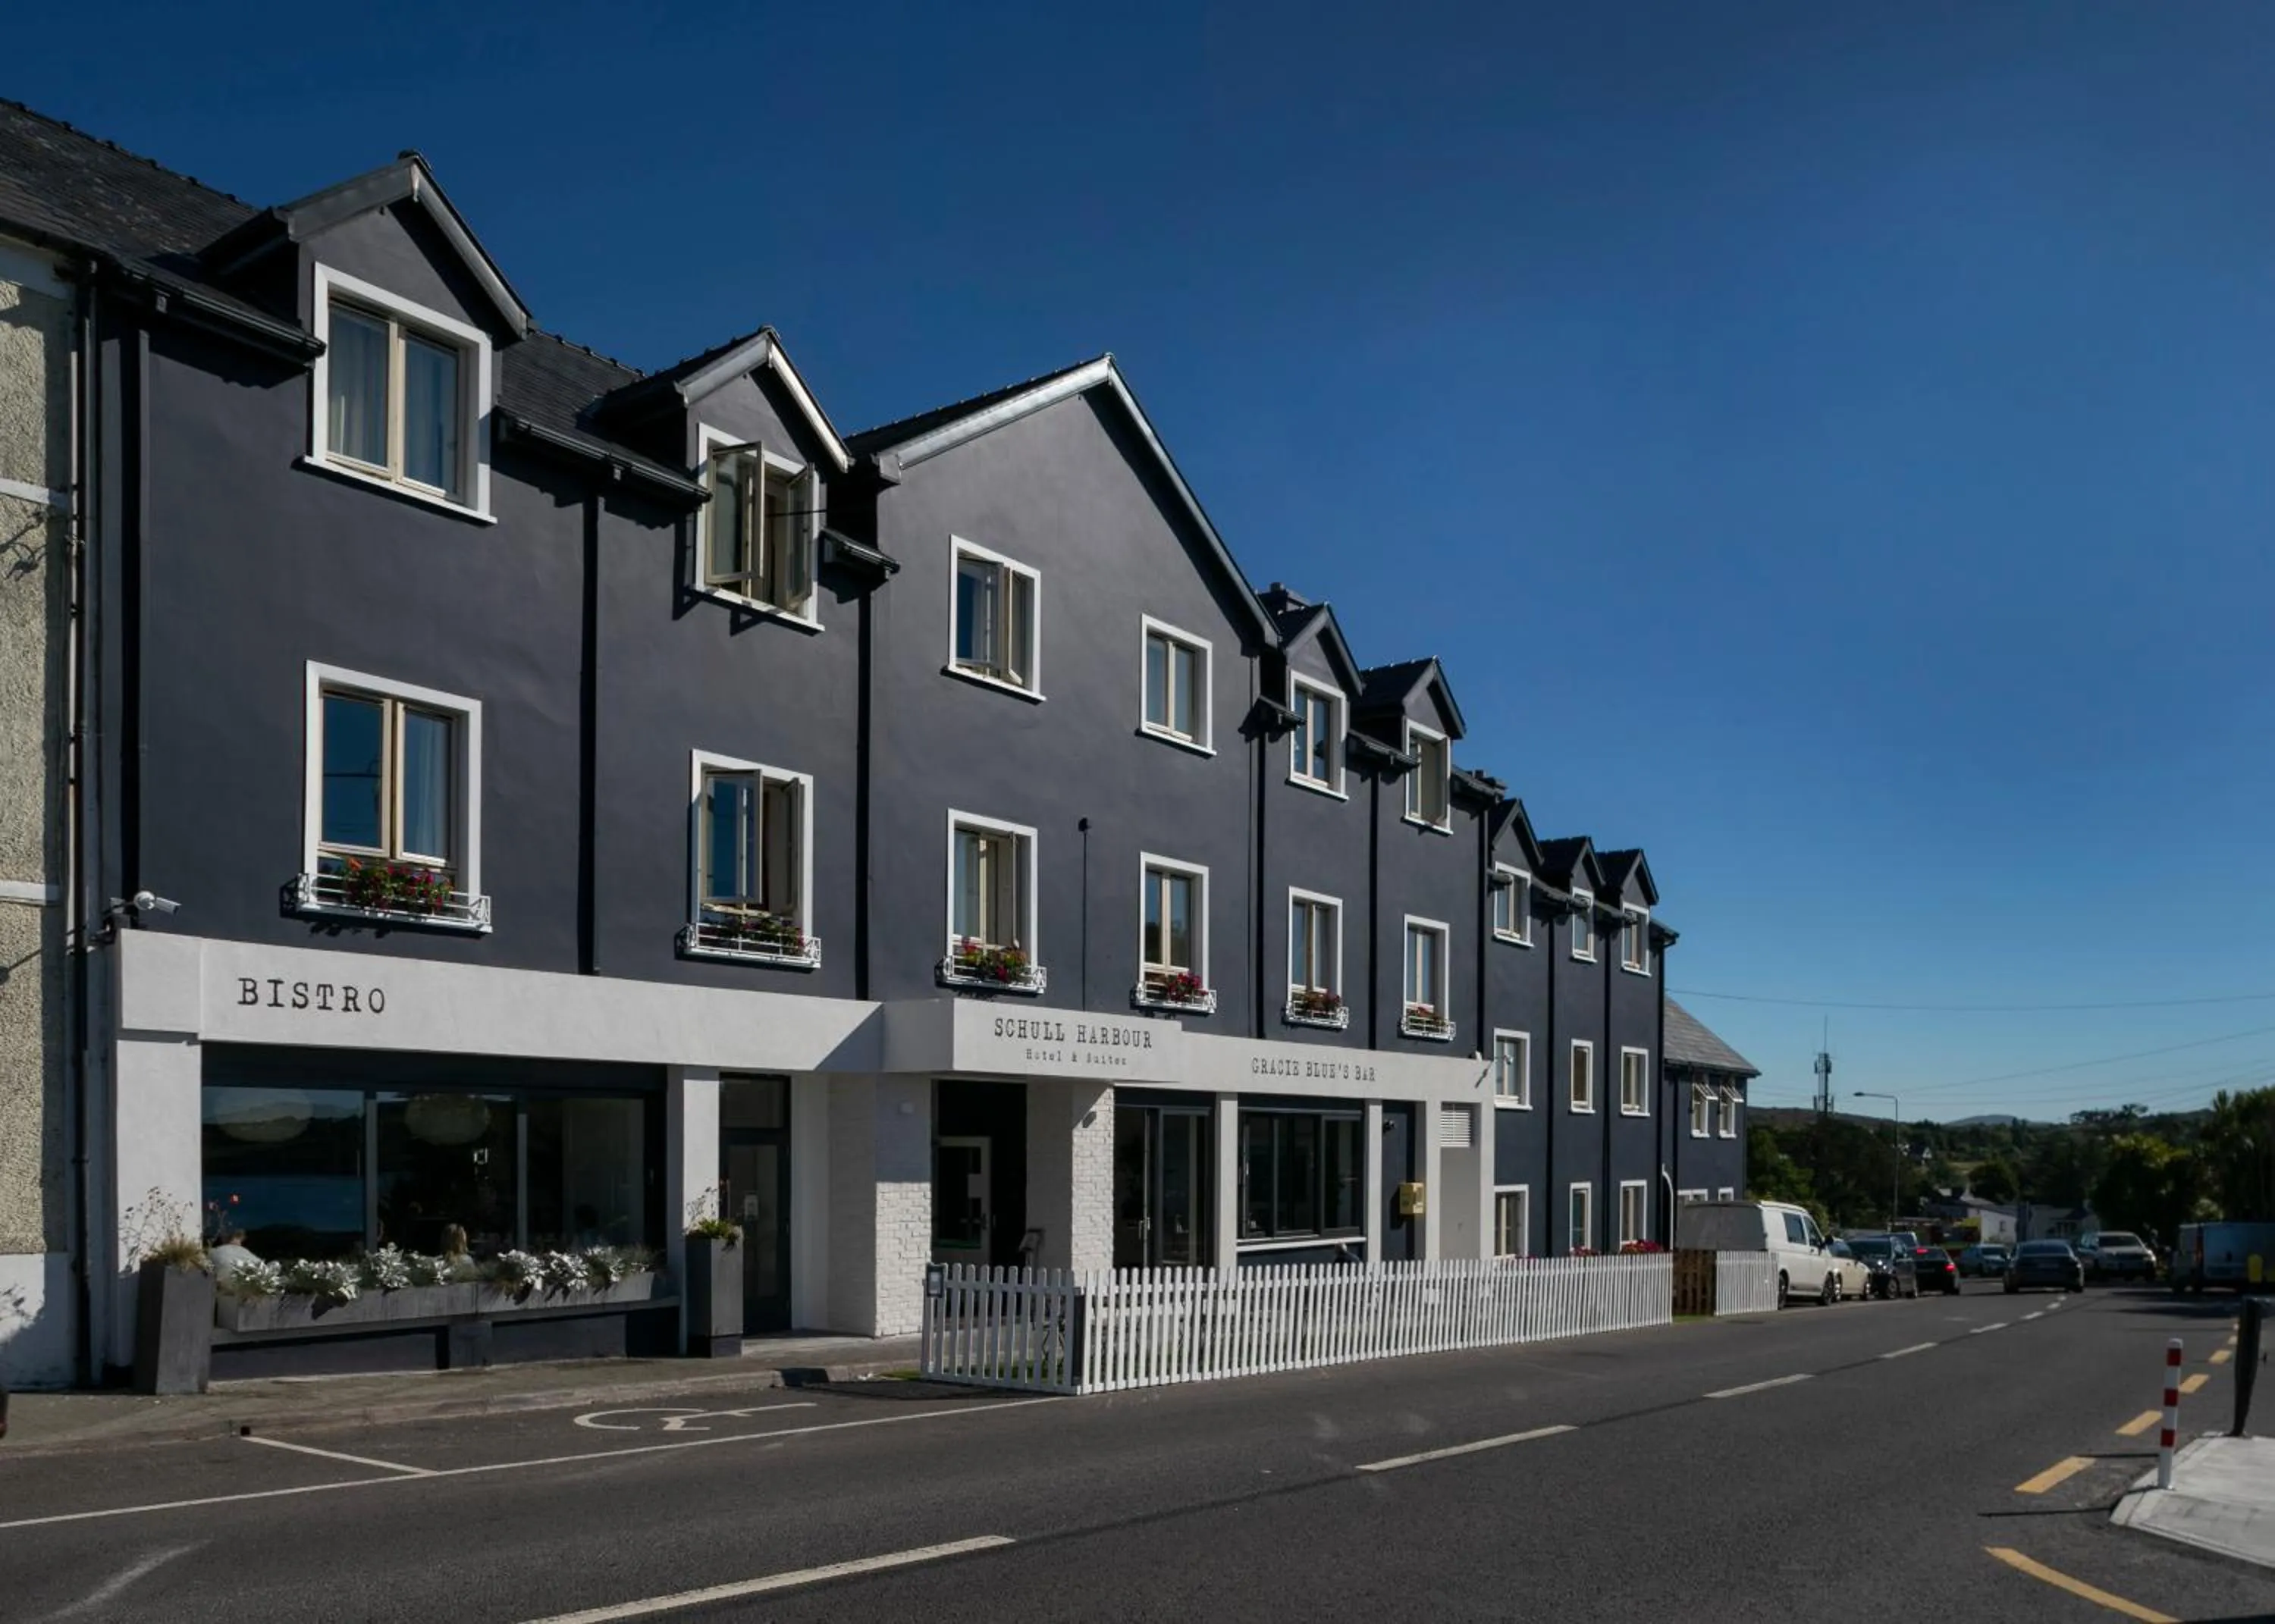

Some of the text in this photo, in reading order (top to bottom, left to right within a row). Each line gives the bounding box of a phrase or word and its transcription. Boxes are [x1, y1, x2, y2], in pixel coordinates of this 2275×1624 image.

[237, 977, 385, 1013] BISTRO
[994, 1017, 1153, 1049] SCHULL HARBOUR
[1026, 1049, 1127, 1065] Hotel & Suites
[1252, 1058, 1376, 1081] GRACIE BLUE'S BAR
